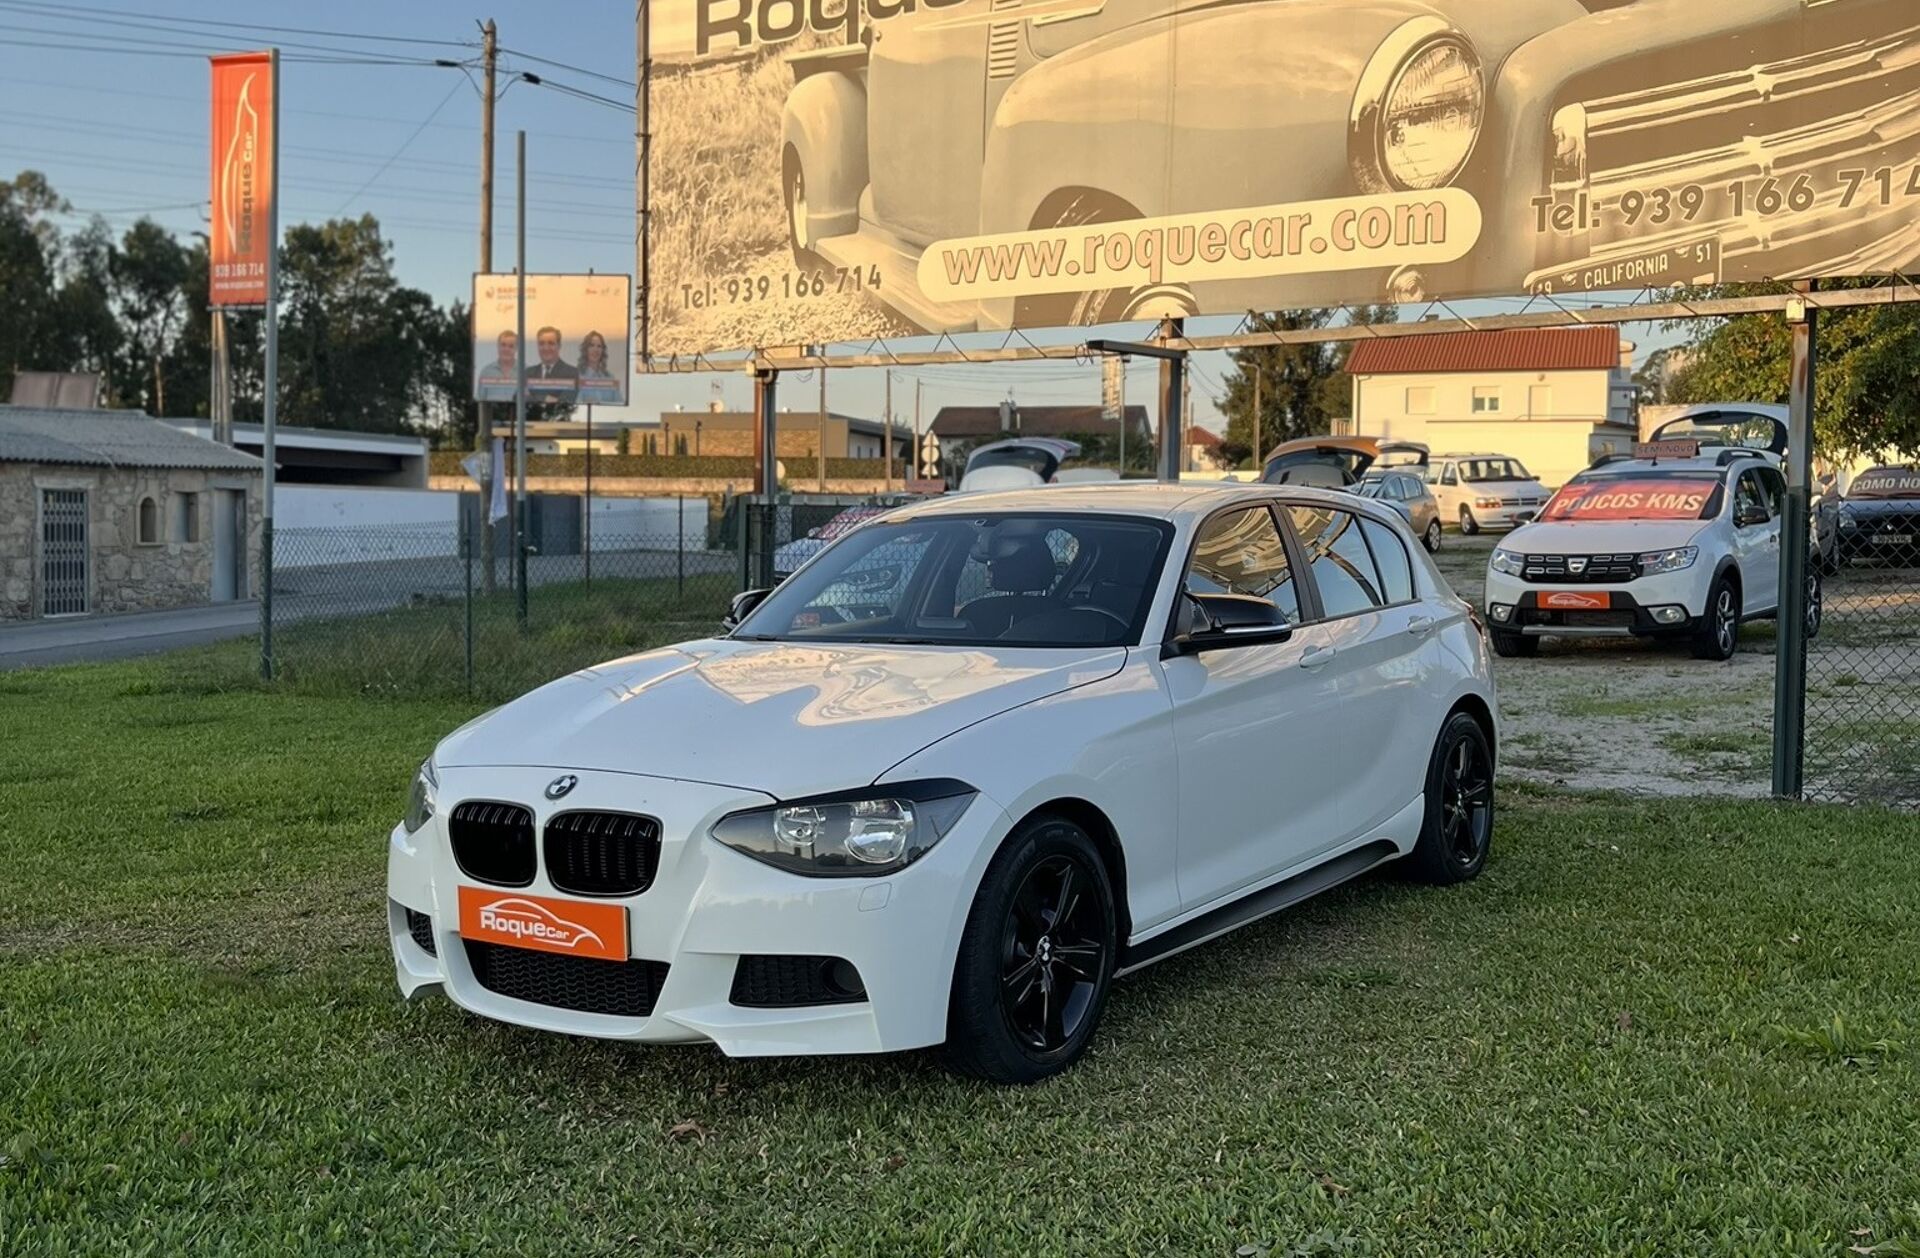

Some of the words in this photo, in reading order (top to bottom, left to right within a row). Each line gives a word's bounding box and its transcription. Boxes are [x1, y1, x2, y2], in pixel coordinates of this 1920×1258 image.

[1532, 192, 1600, 232] Tel:
[1620, 185, 1704, 225] 939
[1728, 175, 1815, 216] 166
[942, 200, 1447, 283] www.roquecar.com
[681, 281, 718, 309] Tel:
[727, 275, 770, 304] 939
[782, 270, 825, 298] 166
[836, 264, 881, 294] 714
[1584, 253, 1668, 289] CALIFORNIA
[1696, 243, 1711, 263] 51
[1552, 493, 1646, 515] POUCOS
[1645, 493, 1703, 512] KMS
[1852, 477, 1896, 492] COMO
